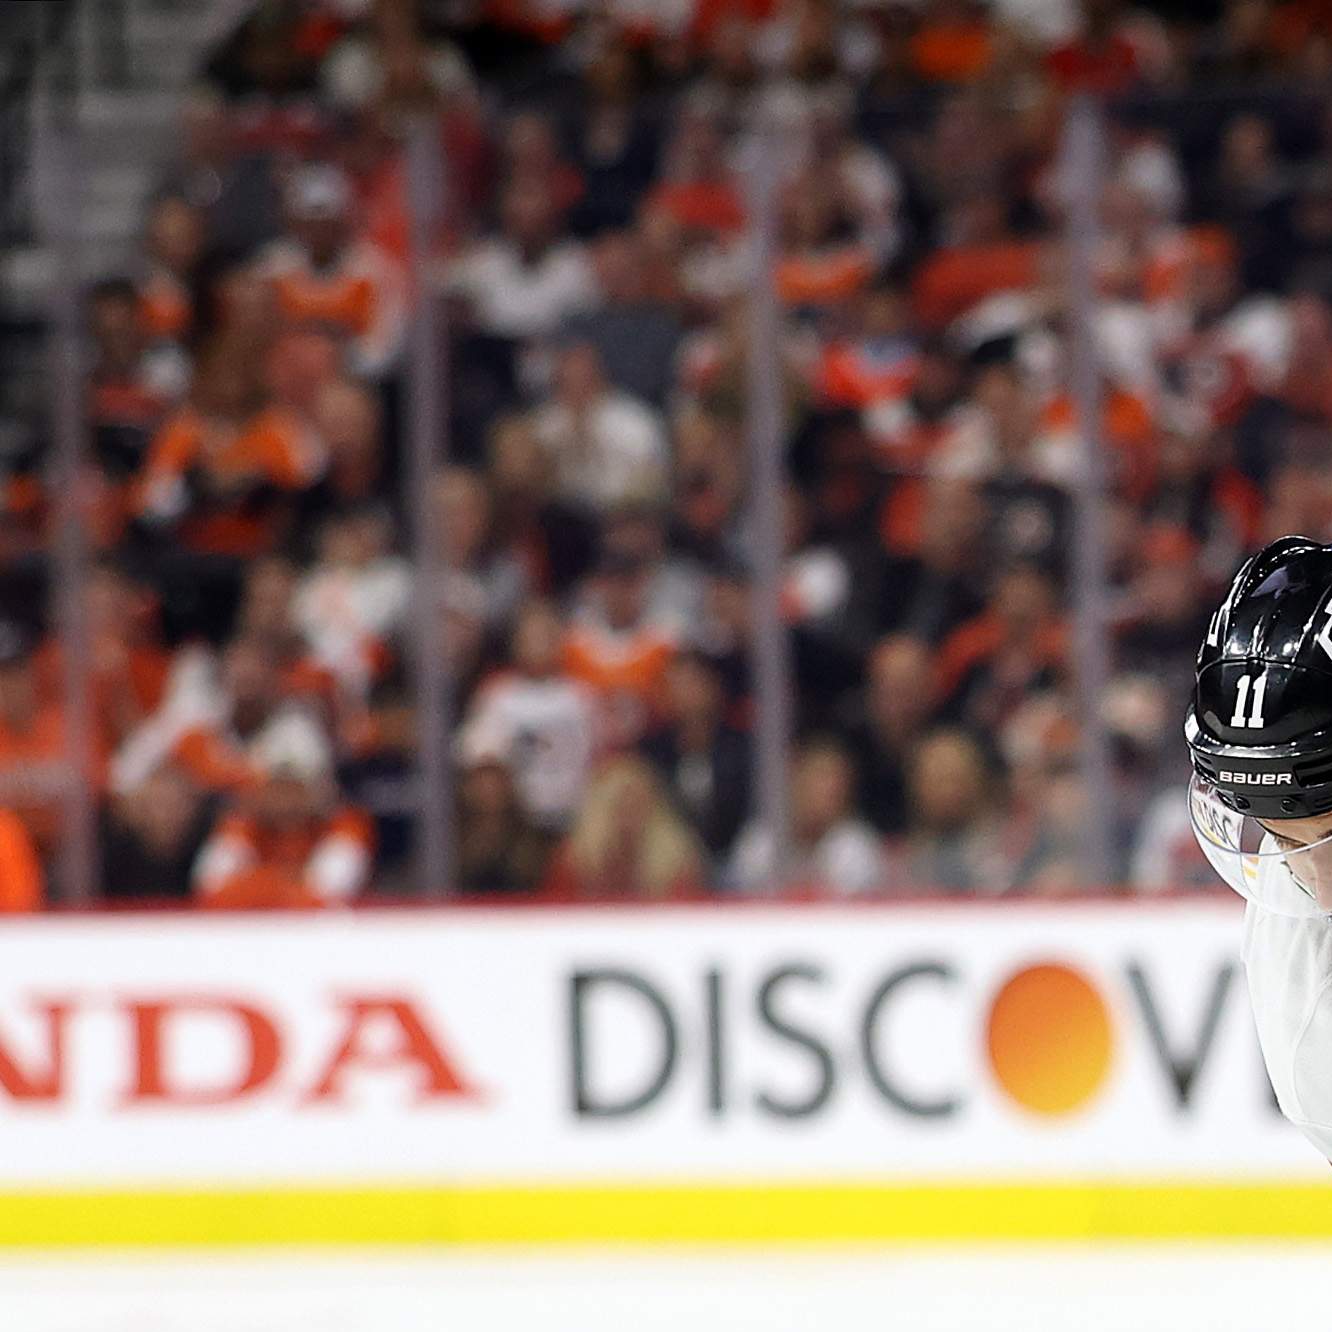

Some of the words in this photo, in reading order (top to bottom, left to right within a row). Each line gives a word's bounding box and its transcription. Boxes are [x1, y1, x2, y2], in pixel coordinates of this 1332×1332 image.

[1230, 674, 1267, 729] 11
[1219, 770, 1293, 786] BAUER
[566, 956, 1283, 1120] DISCOV
